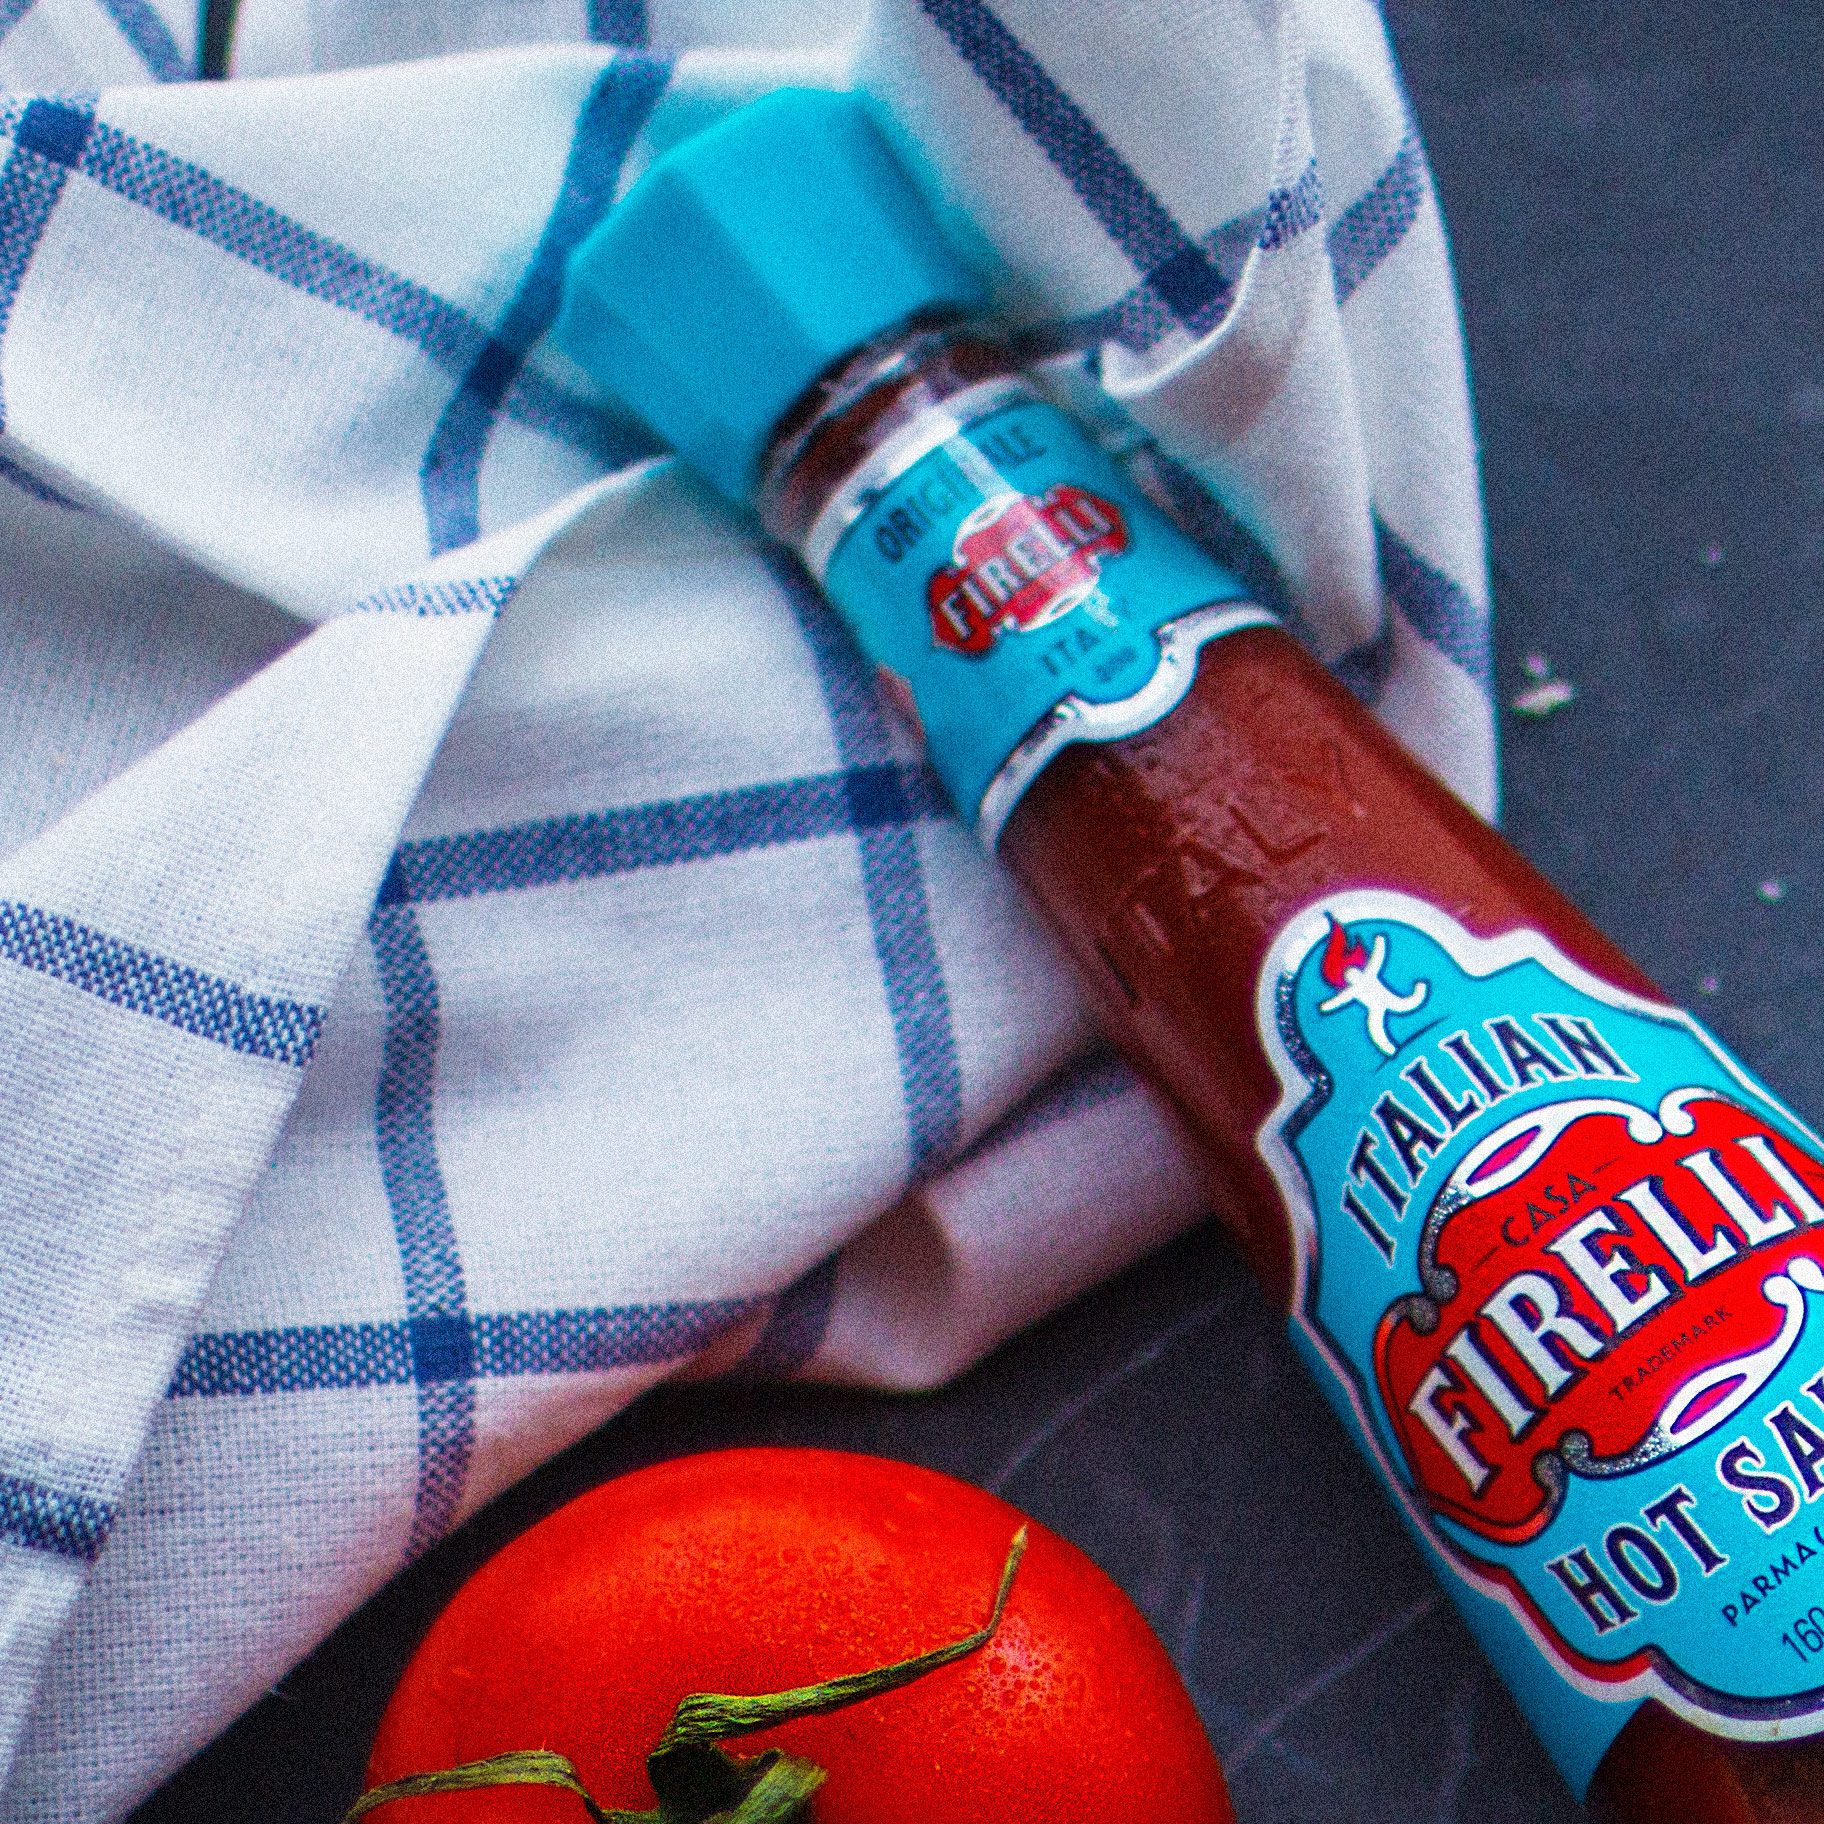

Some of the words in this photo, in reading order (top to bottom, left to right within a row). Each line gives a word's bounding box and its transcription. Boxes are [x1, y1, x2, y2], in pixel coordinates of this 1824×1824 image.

[873, 424, 1049, 563] ORIGILE
[938, 497, 1113, 640] FIRELLI
[1341, 1013, 1640, 1268] ITALIAN
[1501, 1172, 1598, 1247] CASA
[1608, 1305, 1733, 1401] TRADEMARK
[1544, 1484, 1730, 1636] HOT
